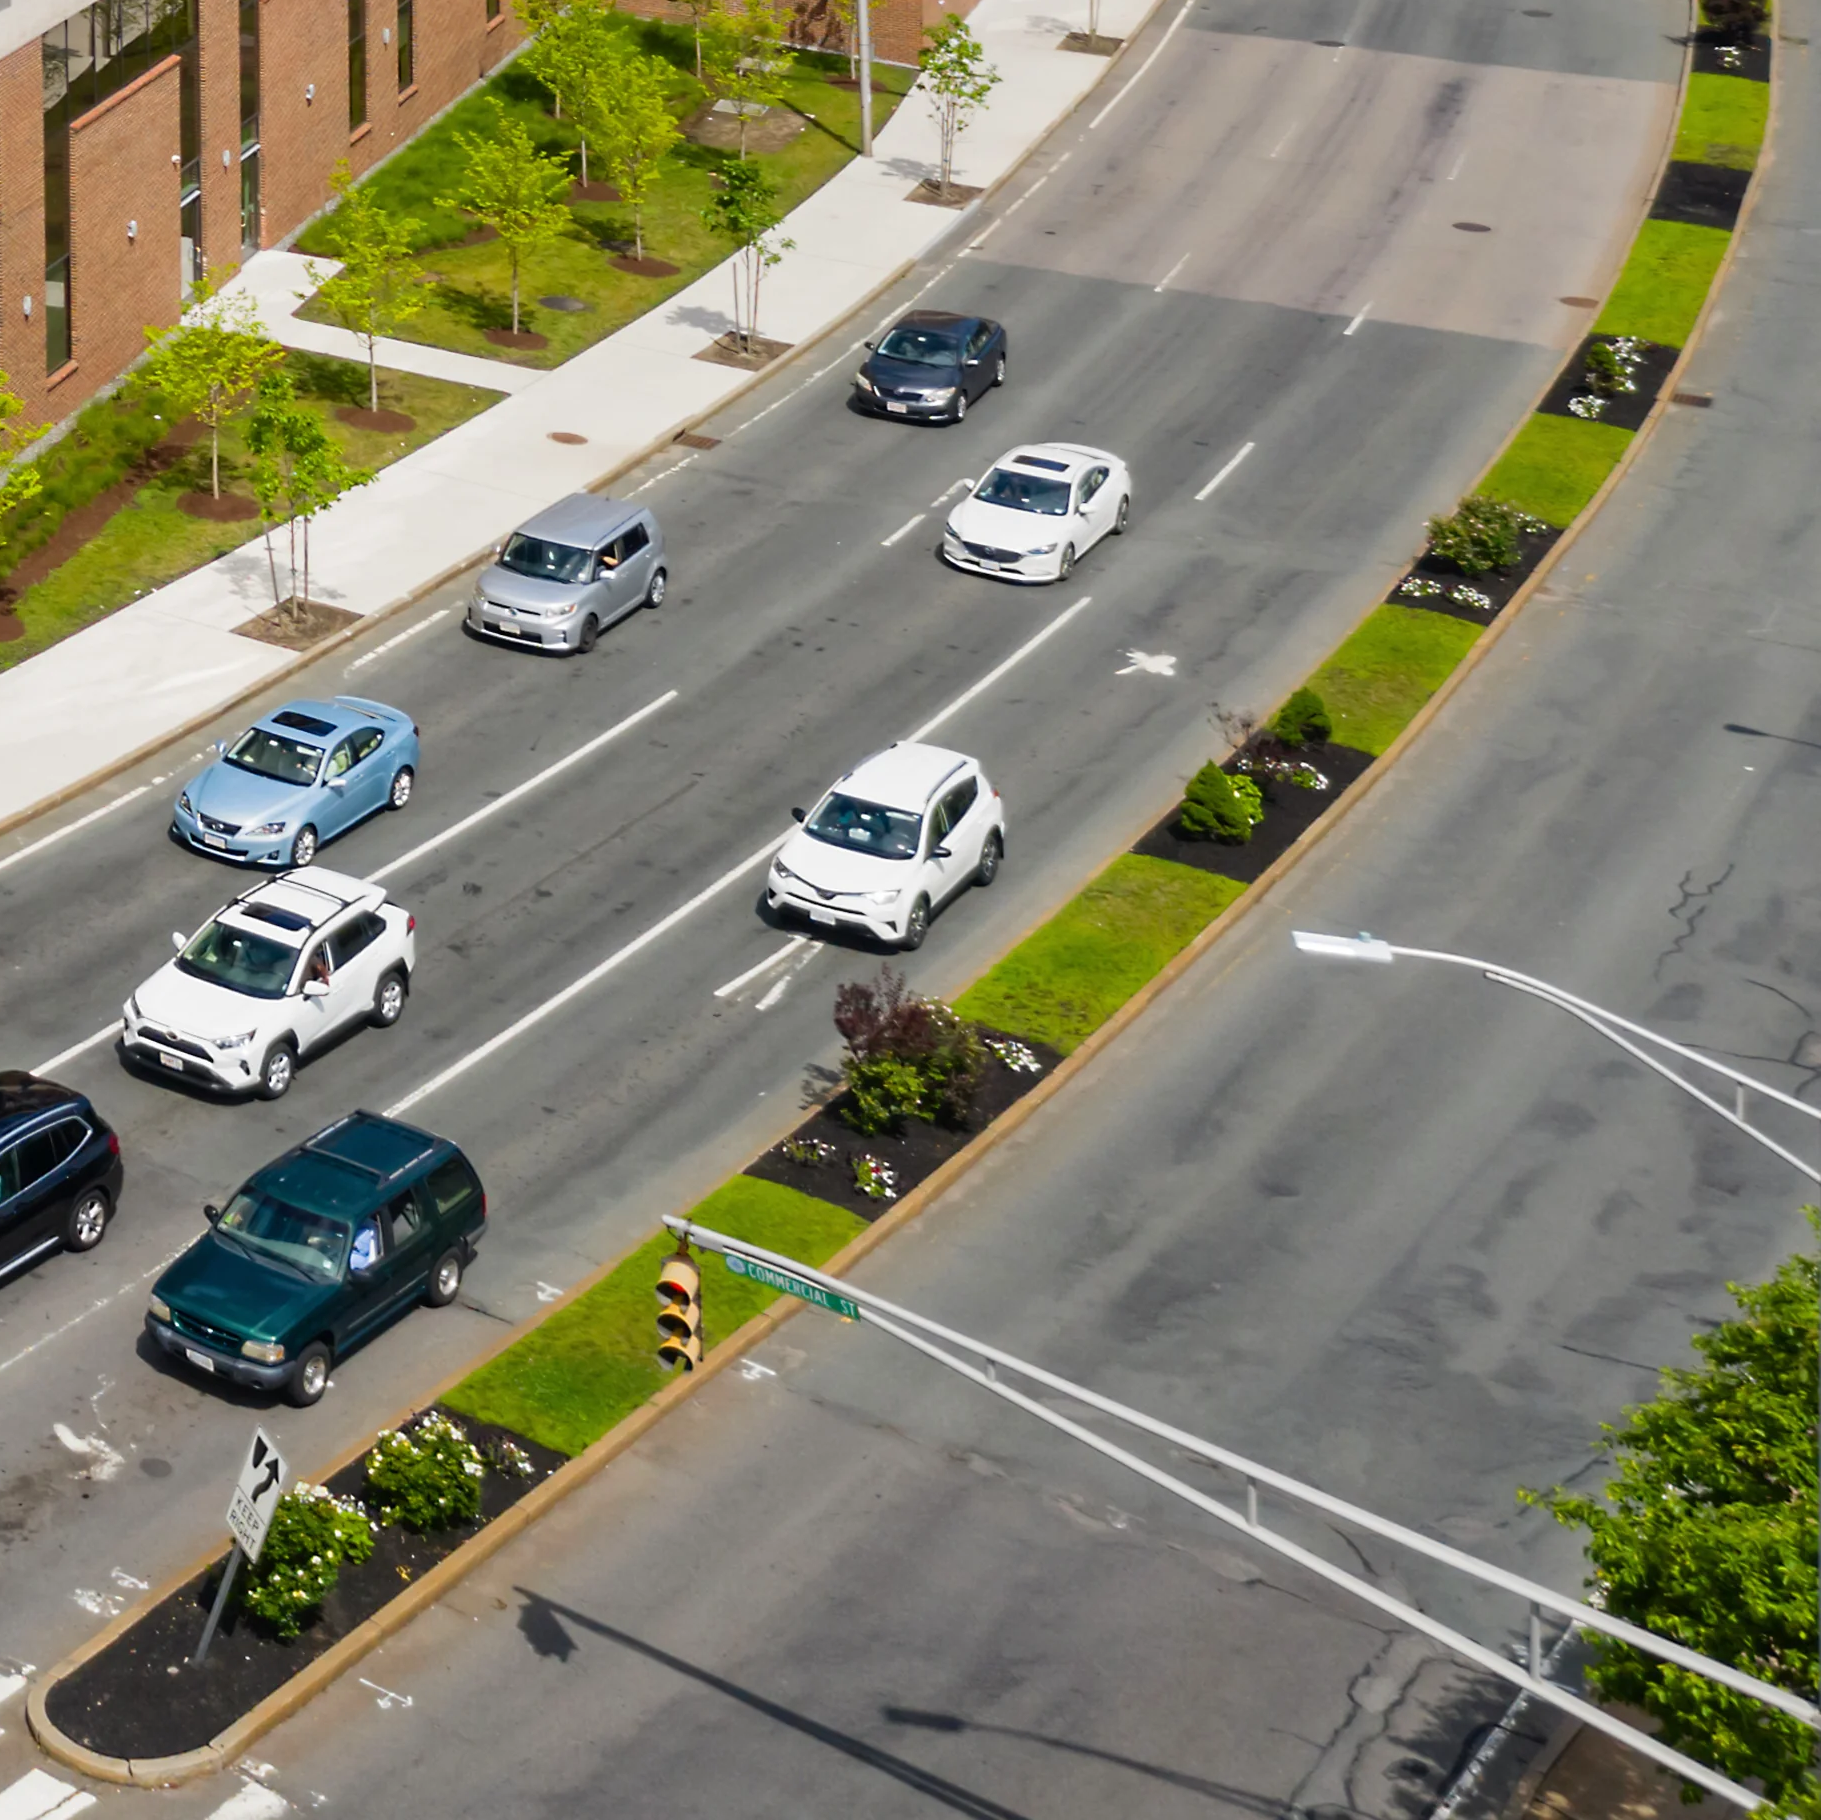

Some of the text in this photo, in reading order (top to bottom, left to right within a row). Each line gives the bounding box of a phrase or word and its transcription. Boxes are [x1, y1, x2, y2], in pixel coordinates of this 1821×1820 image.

[747, 1262, 857, 1317] COMMERCIAL ST
[229, 1508, 257, 1550] RIGHT
[236, 1498, 259, 1531] KEEP
